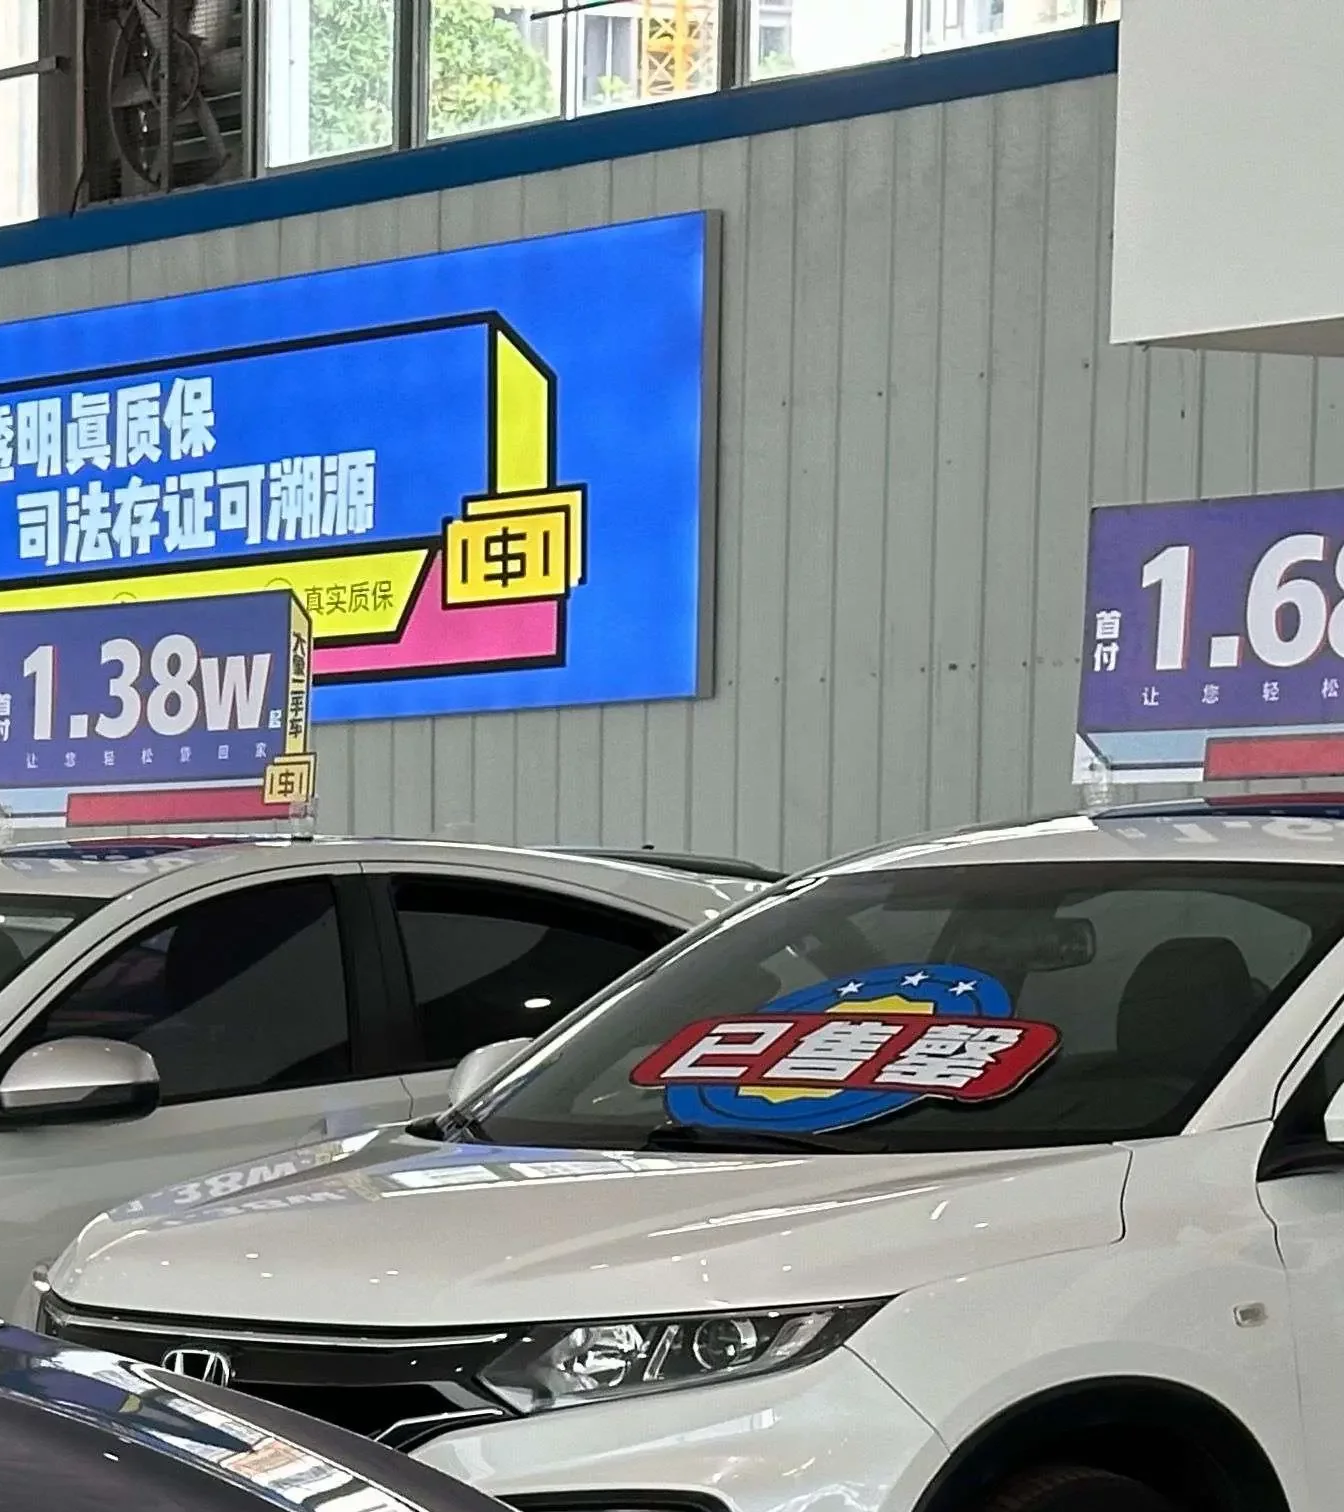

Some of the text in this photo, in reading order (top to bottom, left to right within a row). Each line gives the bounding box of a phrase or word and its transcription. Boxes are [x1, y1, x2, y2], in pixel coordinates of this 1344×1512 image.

[16, 449, 376, 567] 司法存证可溯源
[303, 579, 395, 615] 真实质保
[1142, 533, 1344, 671] 1.6
[1093, 609, 1122, 672] 首付
[659, 1020, 1024, 1088] 已售罄
